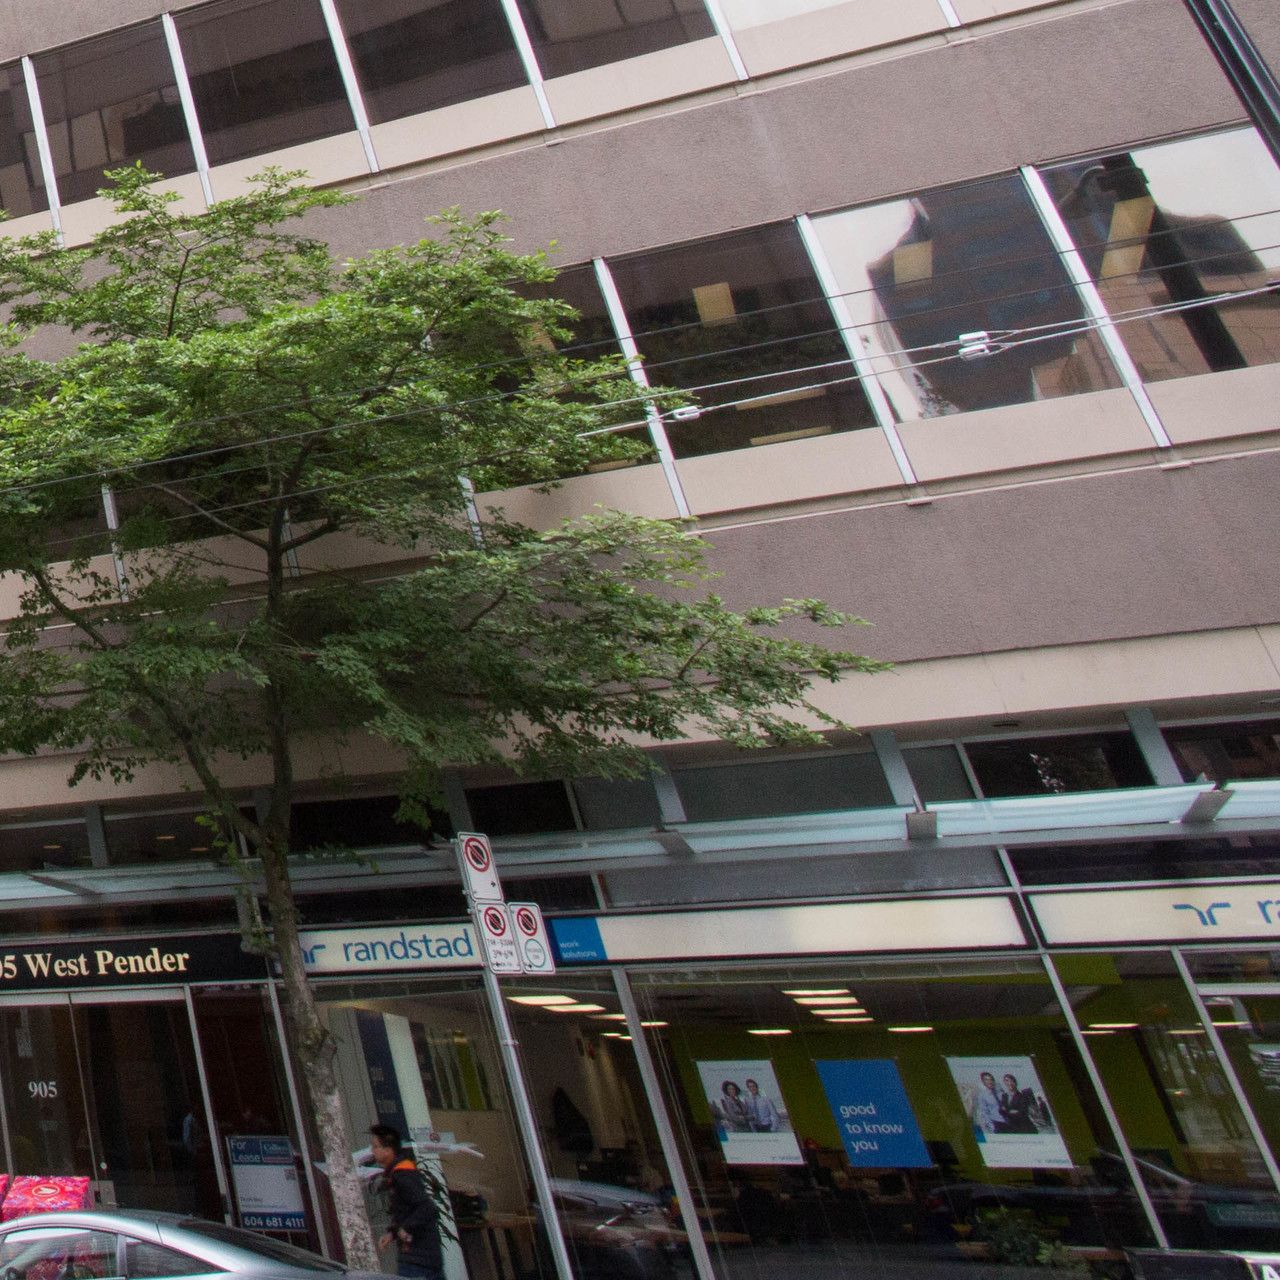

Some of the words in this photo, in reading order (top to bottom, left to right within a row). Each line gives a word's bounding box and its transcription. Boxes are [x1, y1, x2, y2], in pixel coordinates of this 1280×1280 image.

[343, 927, 474, 962] randstad
[560, 940, 580, 949] work
[562, 950, 598, 959] solutions
[23, 952, 90, 978] West
[94, 947, 190, 976] Pender
[28, 1081, 58, 1099] 905
[840, 1102, 876, 1118] good
[845, 1123, 862, 1134] to
[863, 1121, 903, 1134] know
[231, 1140, 246, 1150] For
[851, 1141, 879, 1154] you
[233, 1151, 261, 1163] Lease
[244, 1216, 263, 1227] 604
[266, 1216, 283, 1228] 681
[285, 1216, 305, 1228] 4111
